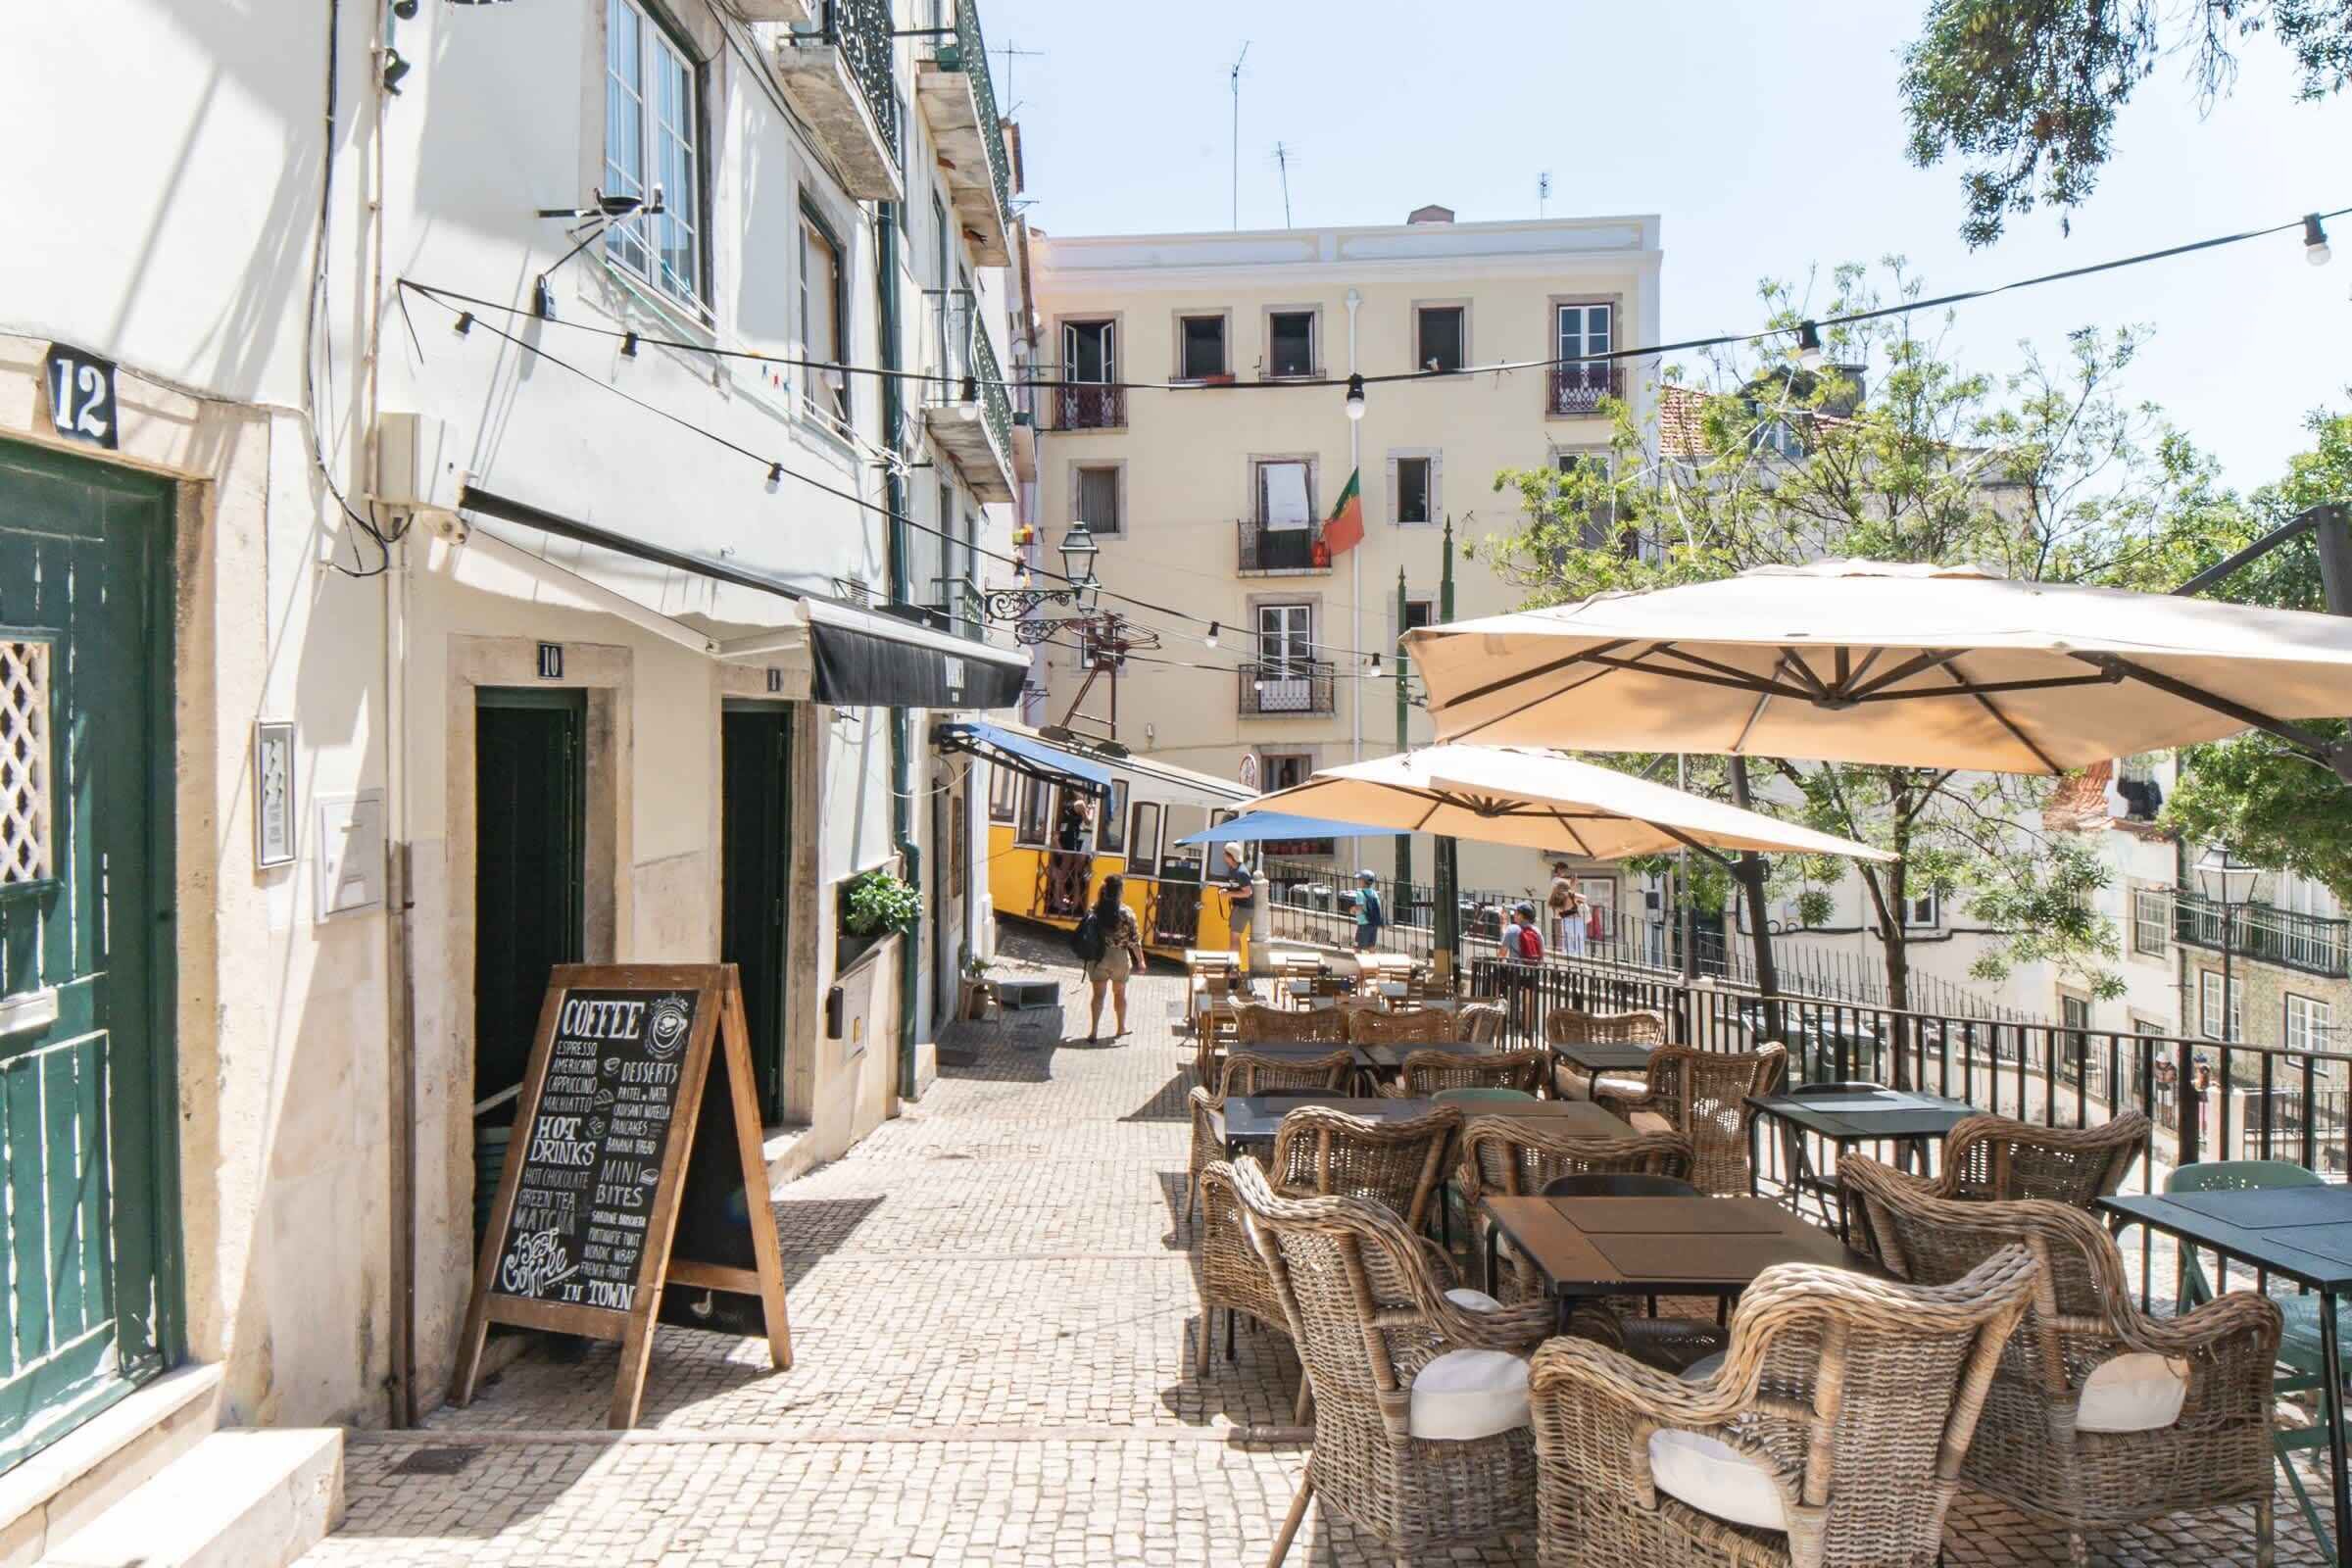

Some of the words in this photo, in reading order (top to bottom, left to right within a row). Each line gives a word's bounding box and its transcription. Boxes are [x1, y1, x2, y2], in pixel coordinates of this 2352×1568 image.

[57, 359, 108, 437] 12
[544, 647, 559, 676] 10
[563, 999, 646, 1040] COFFEE
[556, 1041, 598, 1056] ESPRESSO
[551, 1057, 598, 1075] AMERICANO
[621, 1061, 678, 1084] DESSERTS
[546, 1074, 598, 1094] CAPPUCCINO
[649, 1087, 667, 1102] NATA
[536, 1116, 581, 1141] HOT
[611, 1118, 648, 1136] PANCAKES
[529, 1140, 596, 1166] DRINKS
[606, 1137, 633, 1152] BANANA
[635, 1139, 657, 1154] BREAD
[524, 1167, 543, 1186] HOT
[542, 1168, 591, 1189] CHOCOLATE
[600, 1159, 642, 1184] MINI
[518, 1189, 553, 1207] GREEN
[555, 1191, 575, 1211] TEA
[595, 1184, 644, 1207] BITES
[514, 1207, 575, 1236] MATCHA
[514, 1227, 559, 1264] Best
[584, 1244, 612, 1260] NORDIC
[613, 1249, 637, 1263] WRAP
[503, 1248, 567, 1298] Coffee
[562, 1284, 584, 1301] IN
[588, 1279, 636, 1310] TOWN
